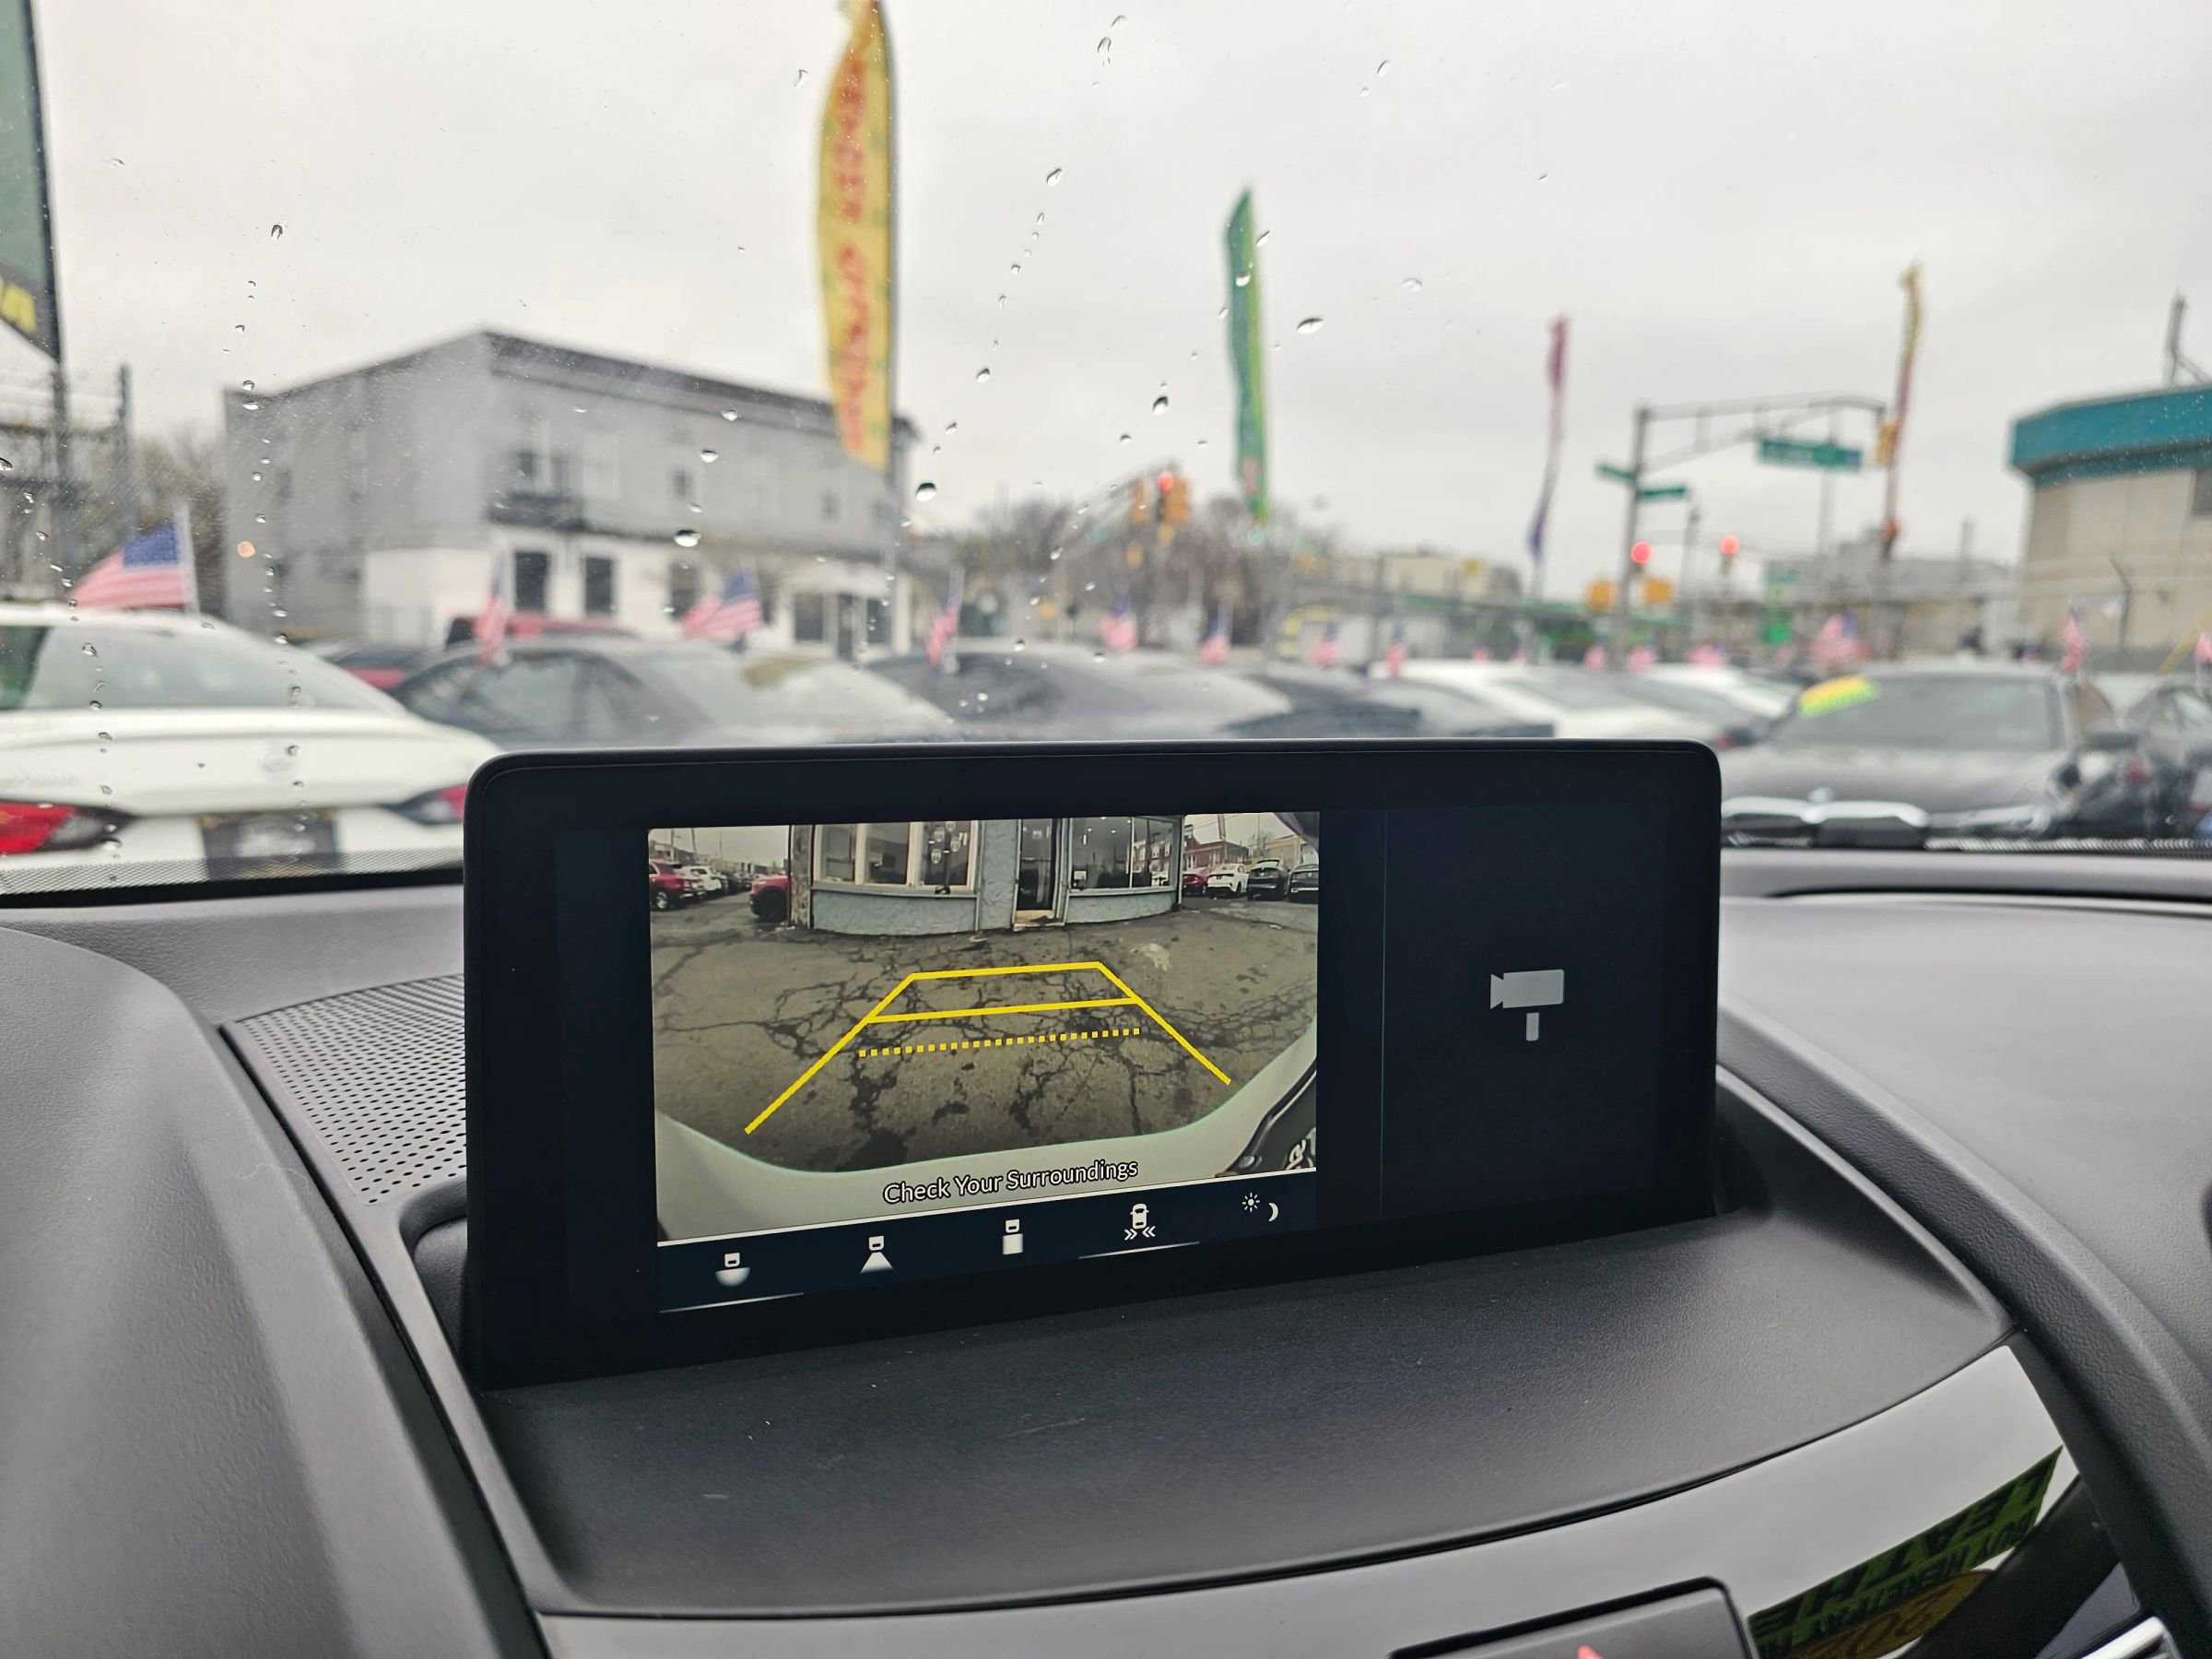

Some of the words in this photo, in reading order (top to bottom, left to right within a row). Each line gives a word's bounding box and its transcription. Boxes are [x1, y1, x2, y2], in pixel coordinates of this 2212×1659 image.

[883, 1177, 951, 1204] Check
[953, 1174, 1003, 1195] Your
[1006, 1159, 1138, 1190] Surroundings
